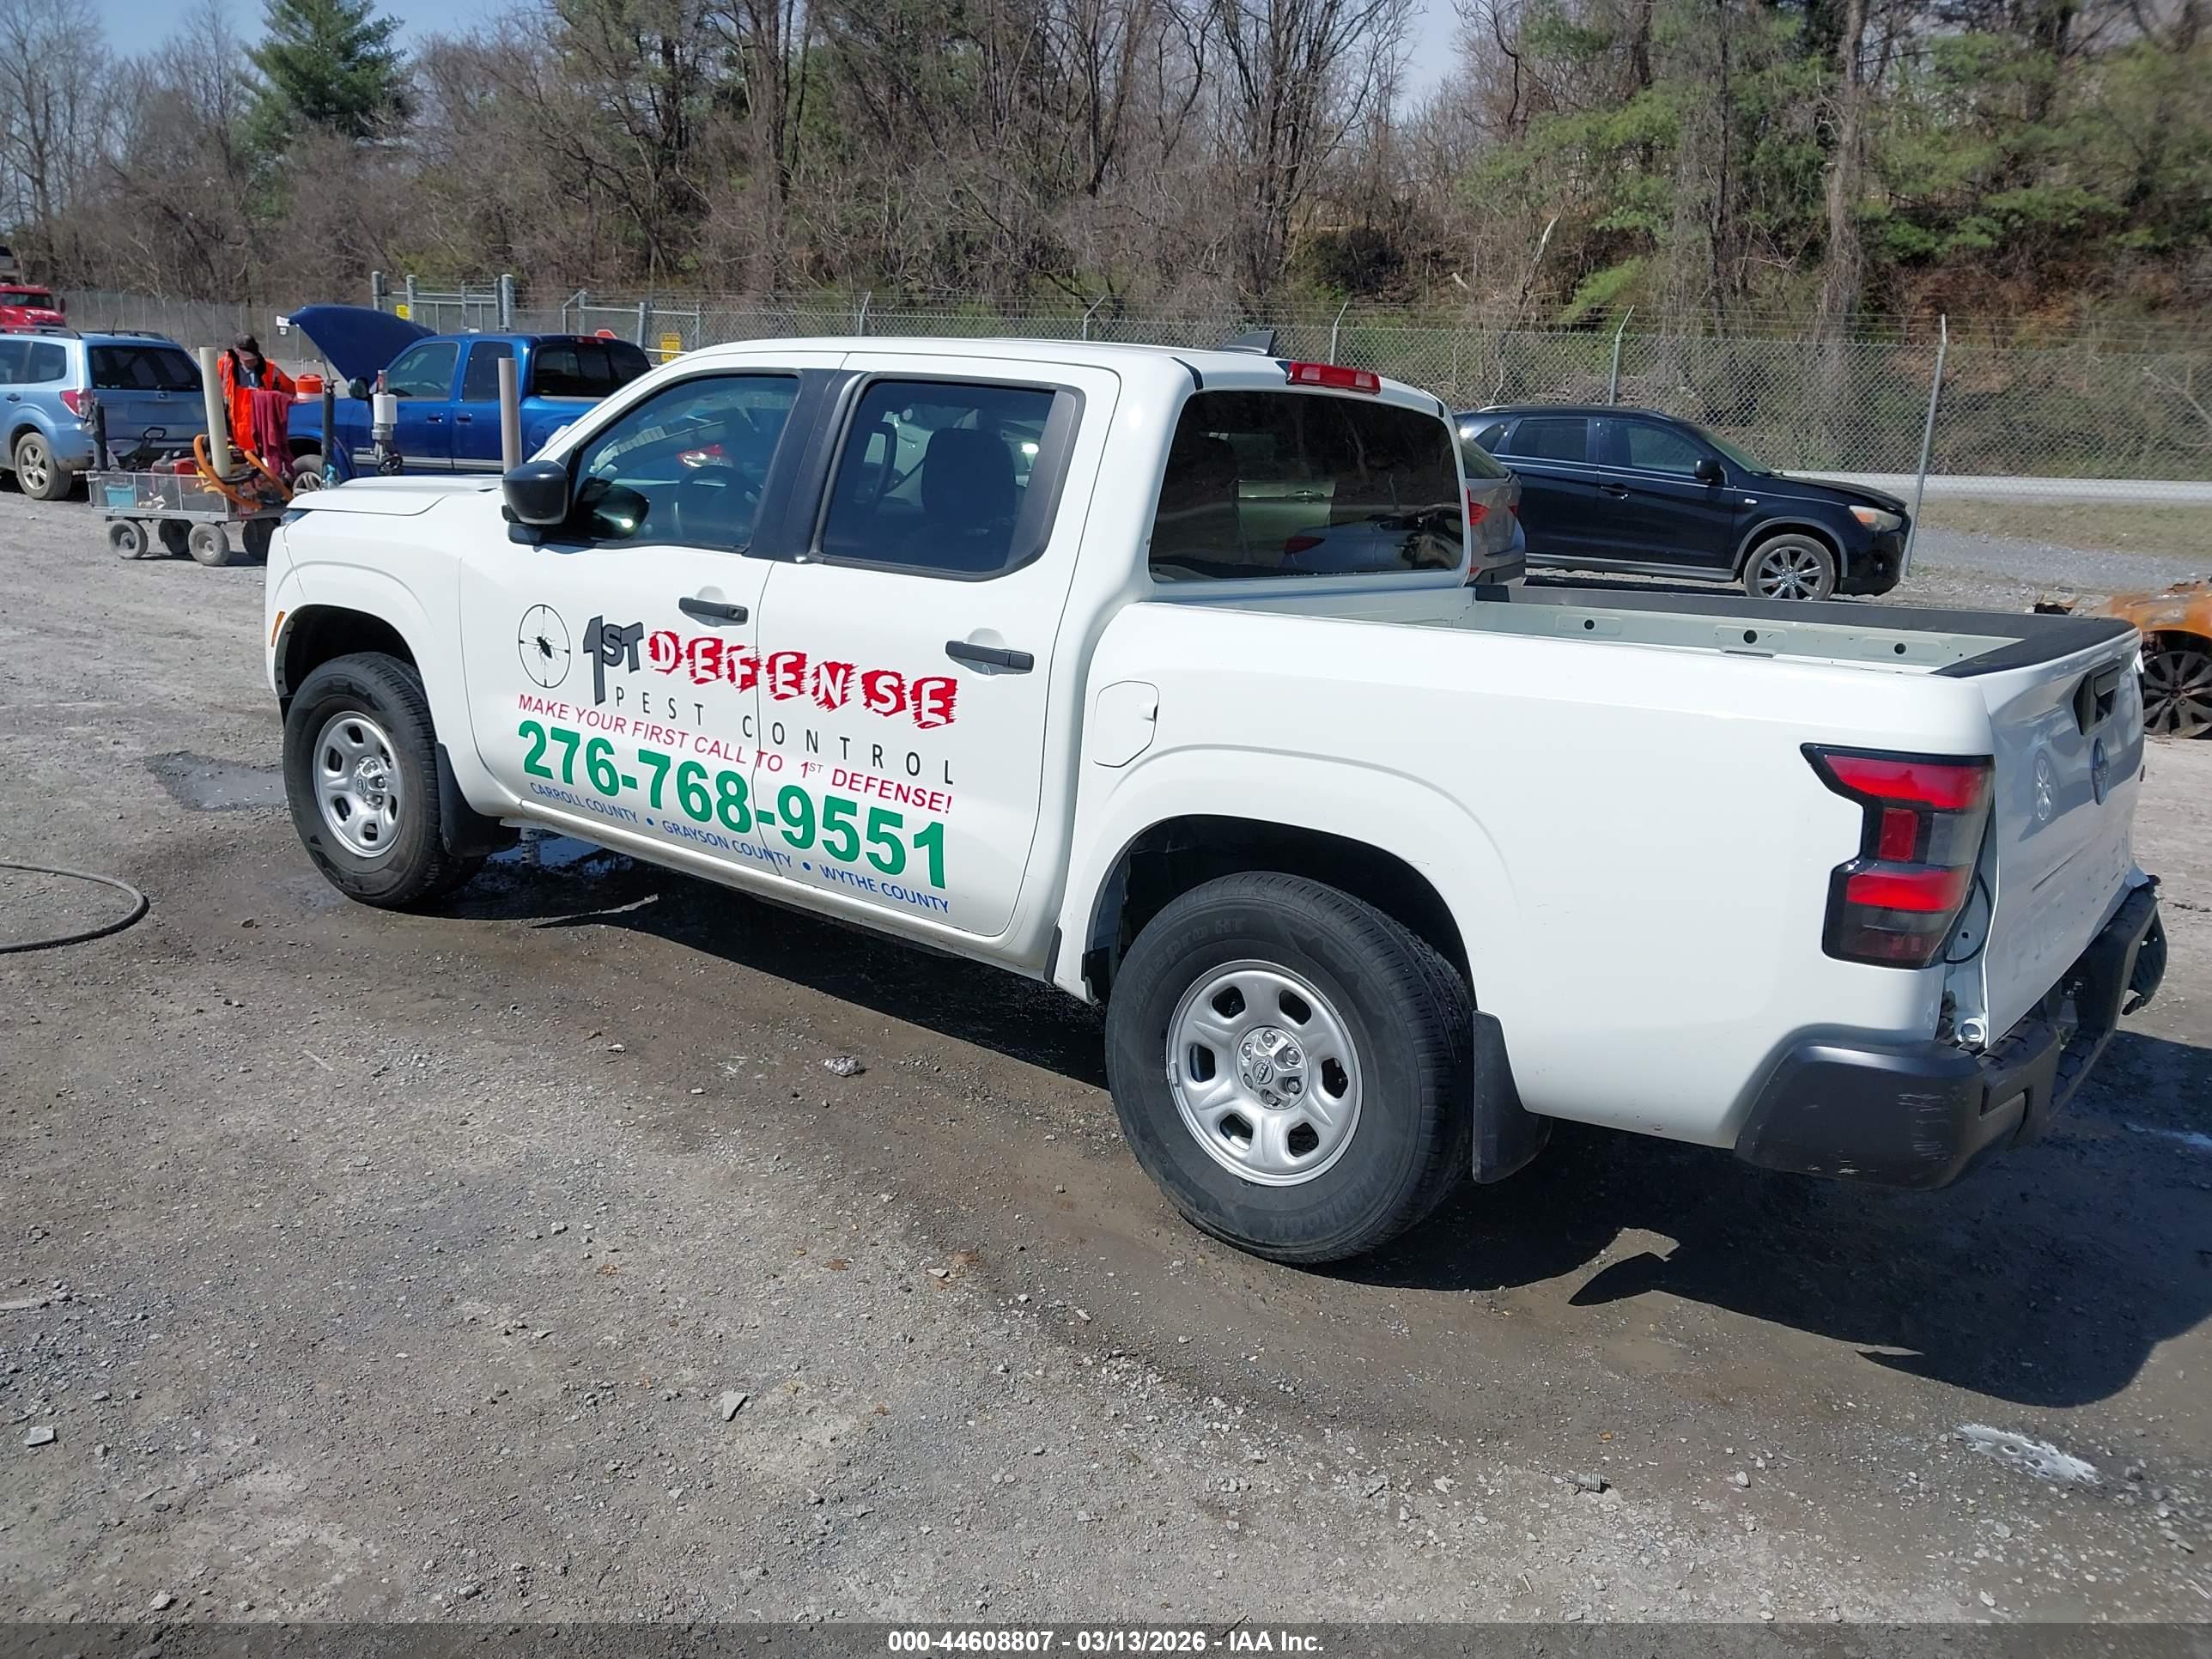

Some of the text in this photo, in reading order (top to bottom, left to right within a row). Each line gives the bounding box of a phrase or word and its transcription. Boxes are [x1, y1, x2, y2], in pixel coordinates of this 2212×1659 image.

[583, 615, 957, 728] 1ST DEFENSE
[518, 694, 952, 814] MAKE YOUR FIRST CALL TO 1ST DEFENSE!
[616, 686, 954, 785] PEST CONTROL
[518, 720, 946, 890] 276-768-9551
[530, 782, 949, 914] CARROLL COUNTY GRAYSON COUNTY WYTHE COUNTY
